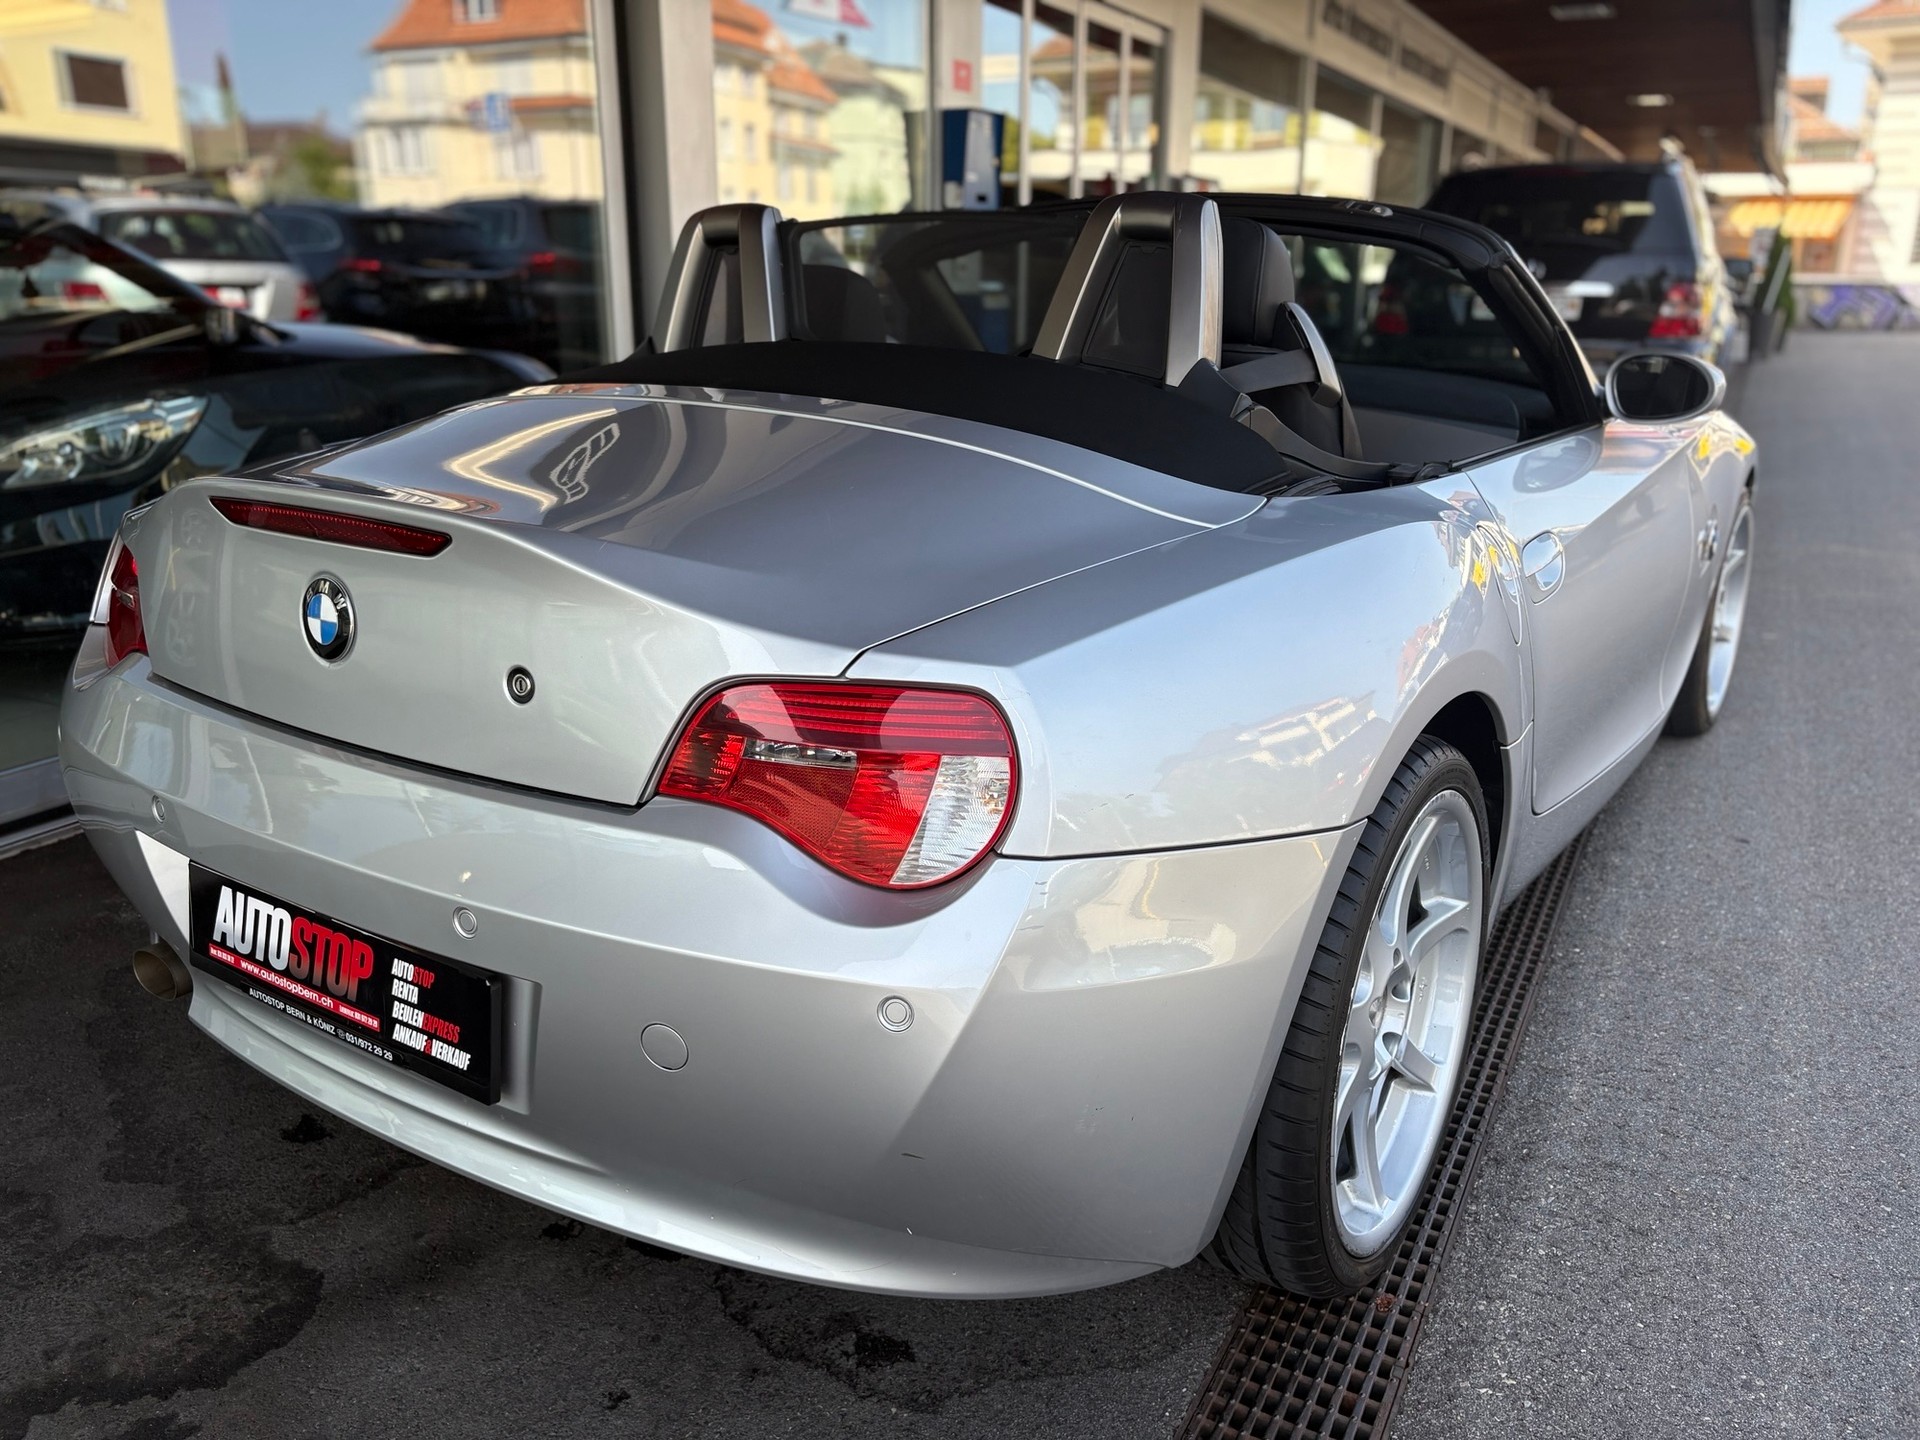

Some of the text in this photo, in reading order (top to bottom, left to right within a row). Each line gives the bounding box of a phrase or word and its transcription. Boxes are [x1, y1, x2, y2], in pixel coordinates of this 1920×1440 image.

[306, 580, 347, 610] BMW
[213, 885, 374, 1002] AUTOSTOP
[240, 960, 334, 1008] www.autostopbern.ch
[391, 958, 435, 989] AUTOSTOP
[391, 978, 419, 1005] RENTA
[249, 988, 286, 1011] AUTOSTOP
[286, 1004, 306, 1021] BERN
[306, 1013, 313, 1023] &
[313, 1016, 336, 1035] KÖNIZ
[345, 1034, 373, 1053] 031/972
[373, 1045, 383, 1057] 29
[383, 1049, 393, 1062] 29
[392, 1000, 460, 1044] BEULENEXPRESS
